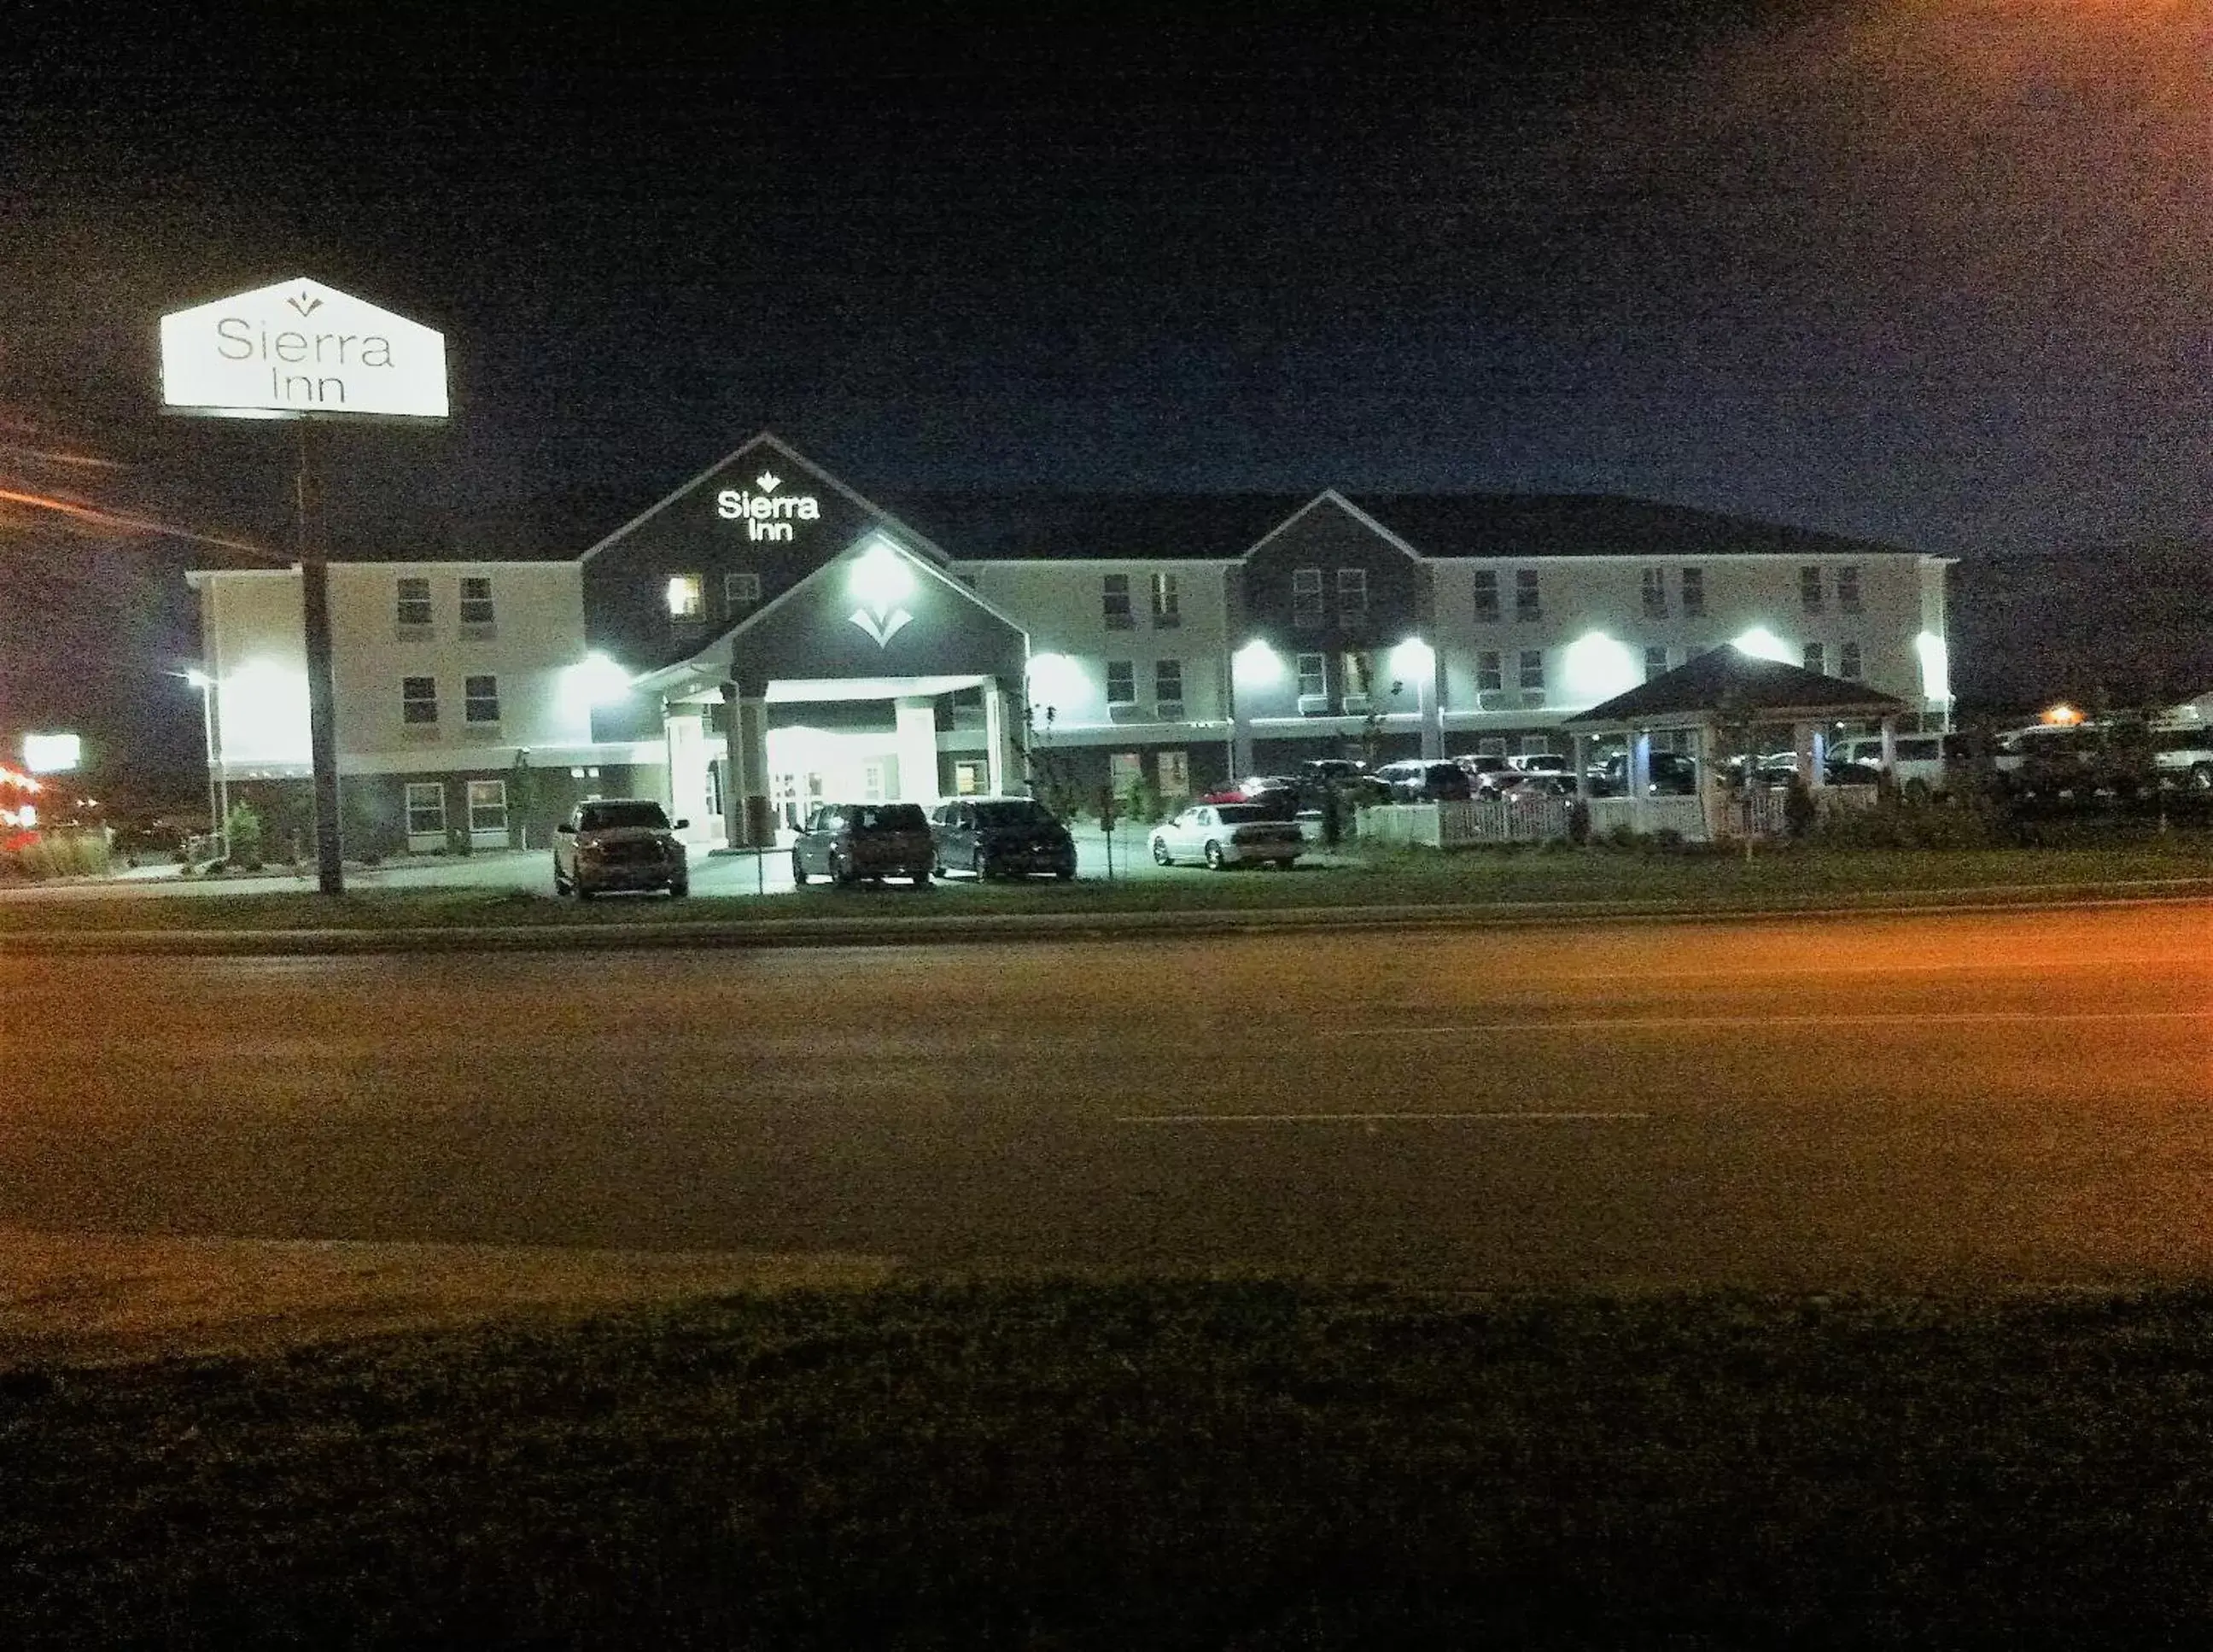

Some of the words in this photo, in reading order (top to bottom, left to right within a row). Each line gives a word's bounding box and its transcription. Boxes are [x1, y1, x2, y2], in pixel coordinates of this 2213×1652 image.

[217, 318, 394, 368] Sierra
[272, 366, 345, 403] Inn
[717, 490, 821, 520] Sierra
[749, 517, 793, 541] Inn
